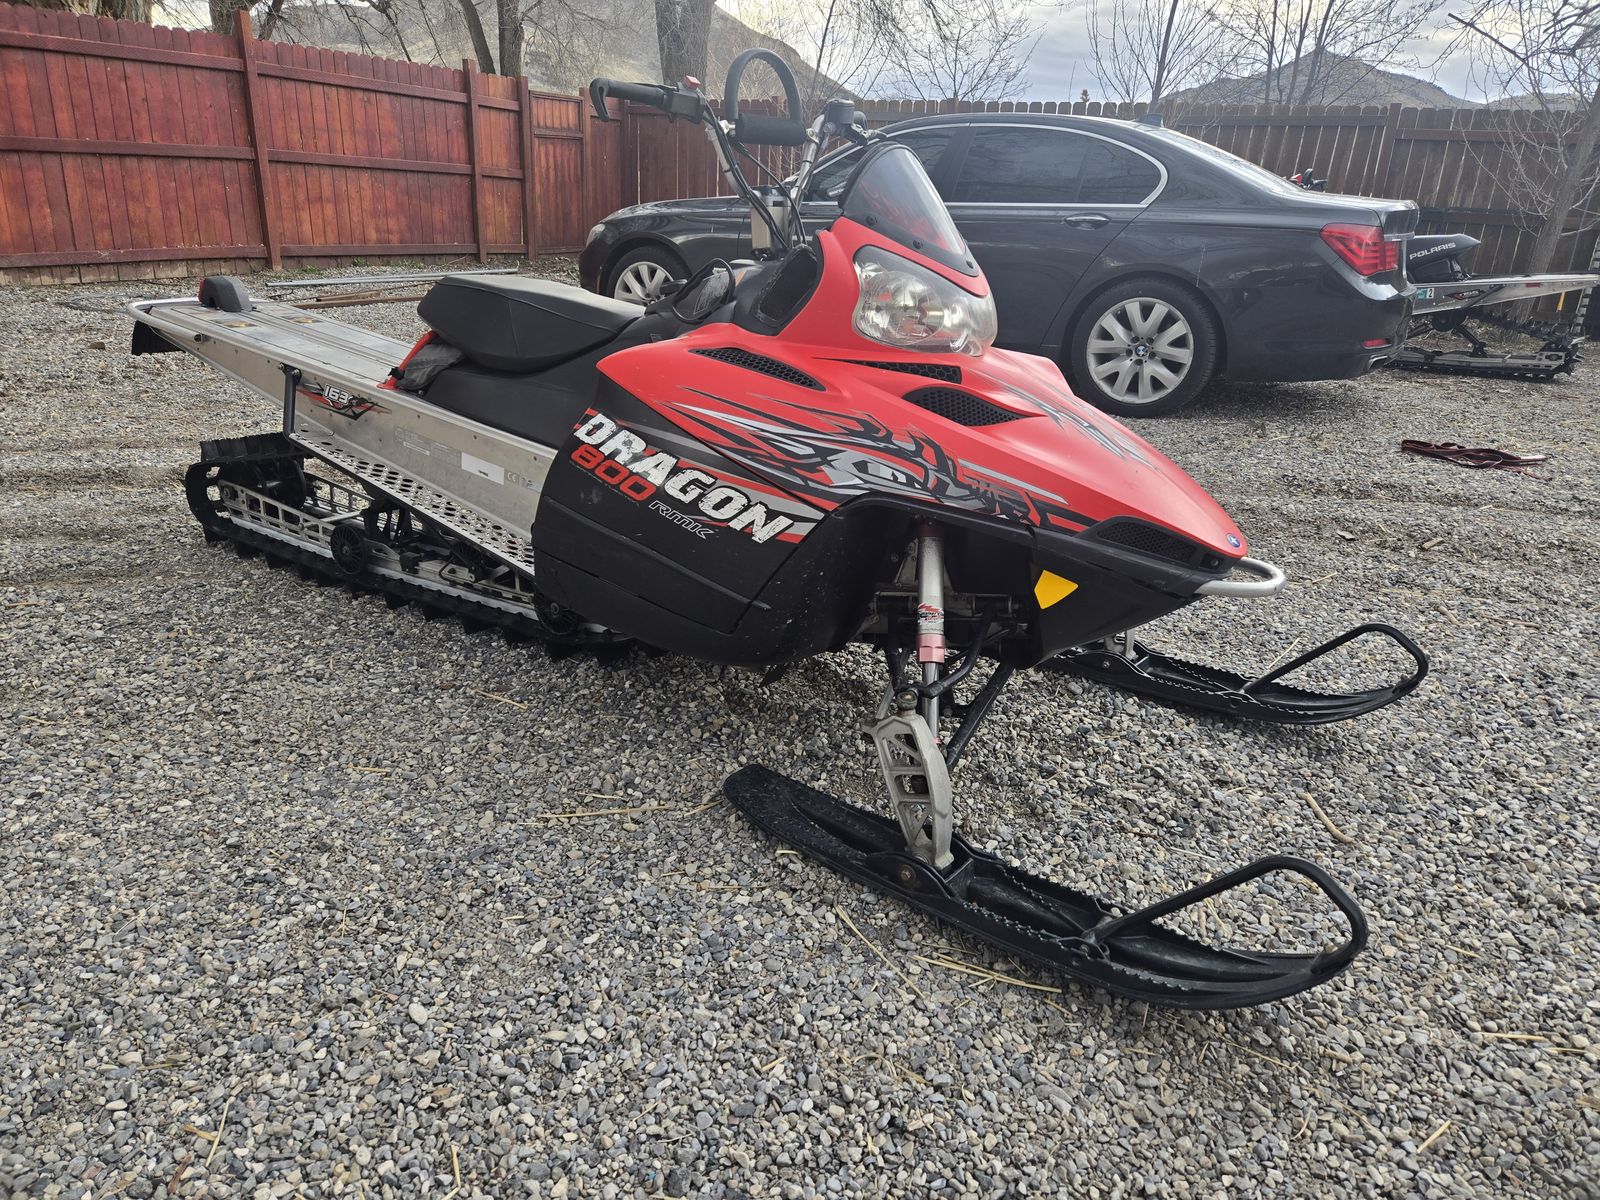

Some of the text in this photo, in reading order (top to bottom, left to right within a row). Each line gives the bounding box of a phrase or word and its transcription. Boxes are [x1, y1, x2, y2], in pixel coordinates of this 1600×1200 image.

[1409, 242, 1456, 260] POLARIS
[1428, 288, 1434, 298] 2
[570, 444, 656, 501] 800
[573, 413, 794, 543] DRAGON
[648, 500, 715, 540] RMK
